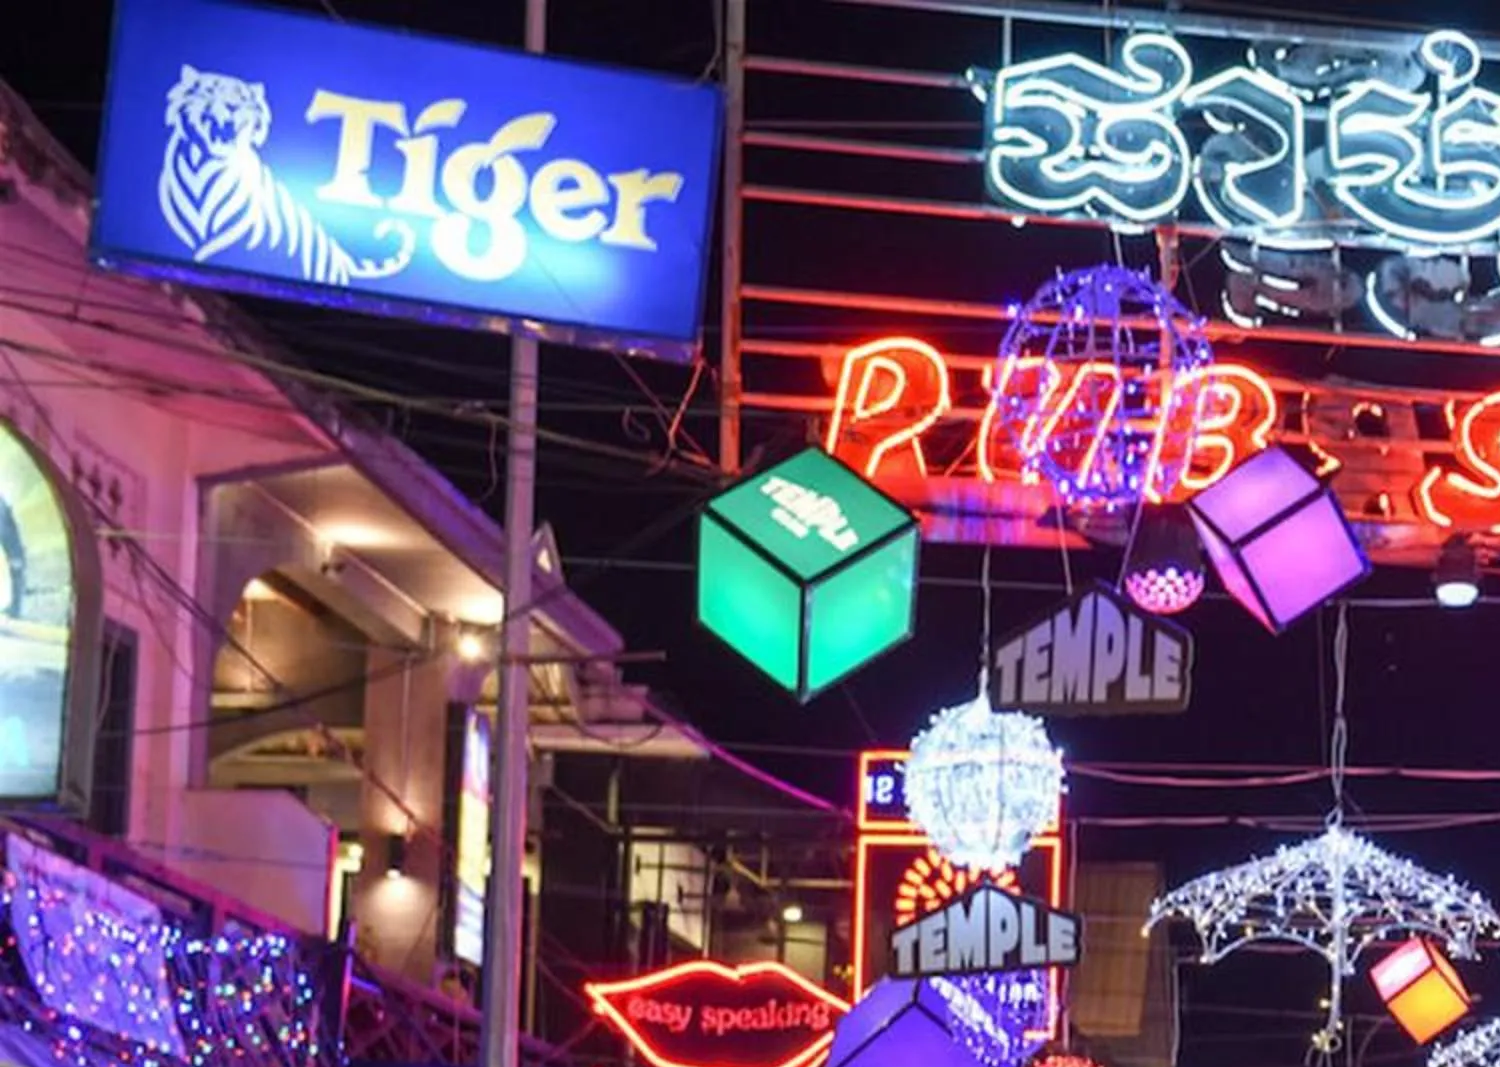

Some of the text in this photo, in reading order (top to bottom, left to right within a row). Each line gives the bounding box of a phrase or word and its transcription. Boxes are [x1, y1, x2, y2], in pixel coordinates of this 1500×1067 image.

[306, 89, 682, 281] Tiger
[827, 337, 1276, 503] PUB
[998, 594, 1184, 702] TEMPLE
[894, 888, 1077, 973] TEMPLE
[627, 996, 830, 1036] easy speaking
